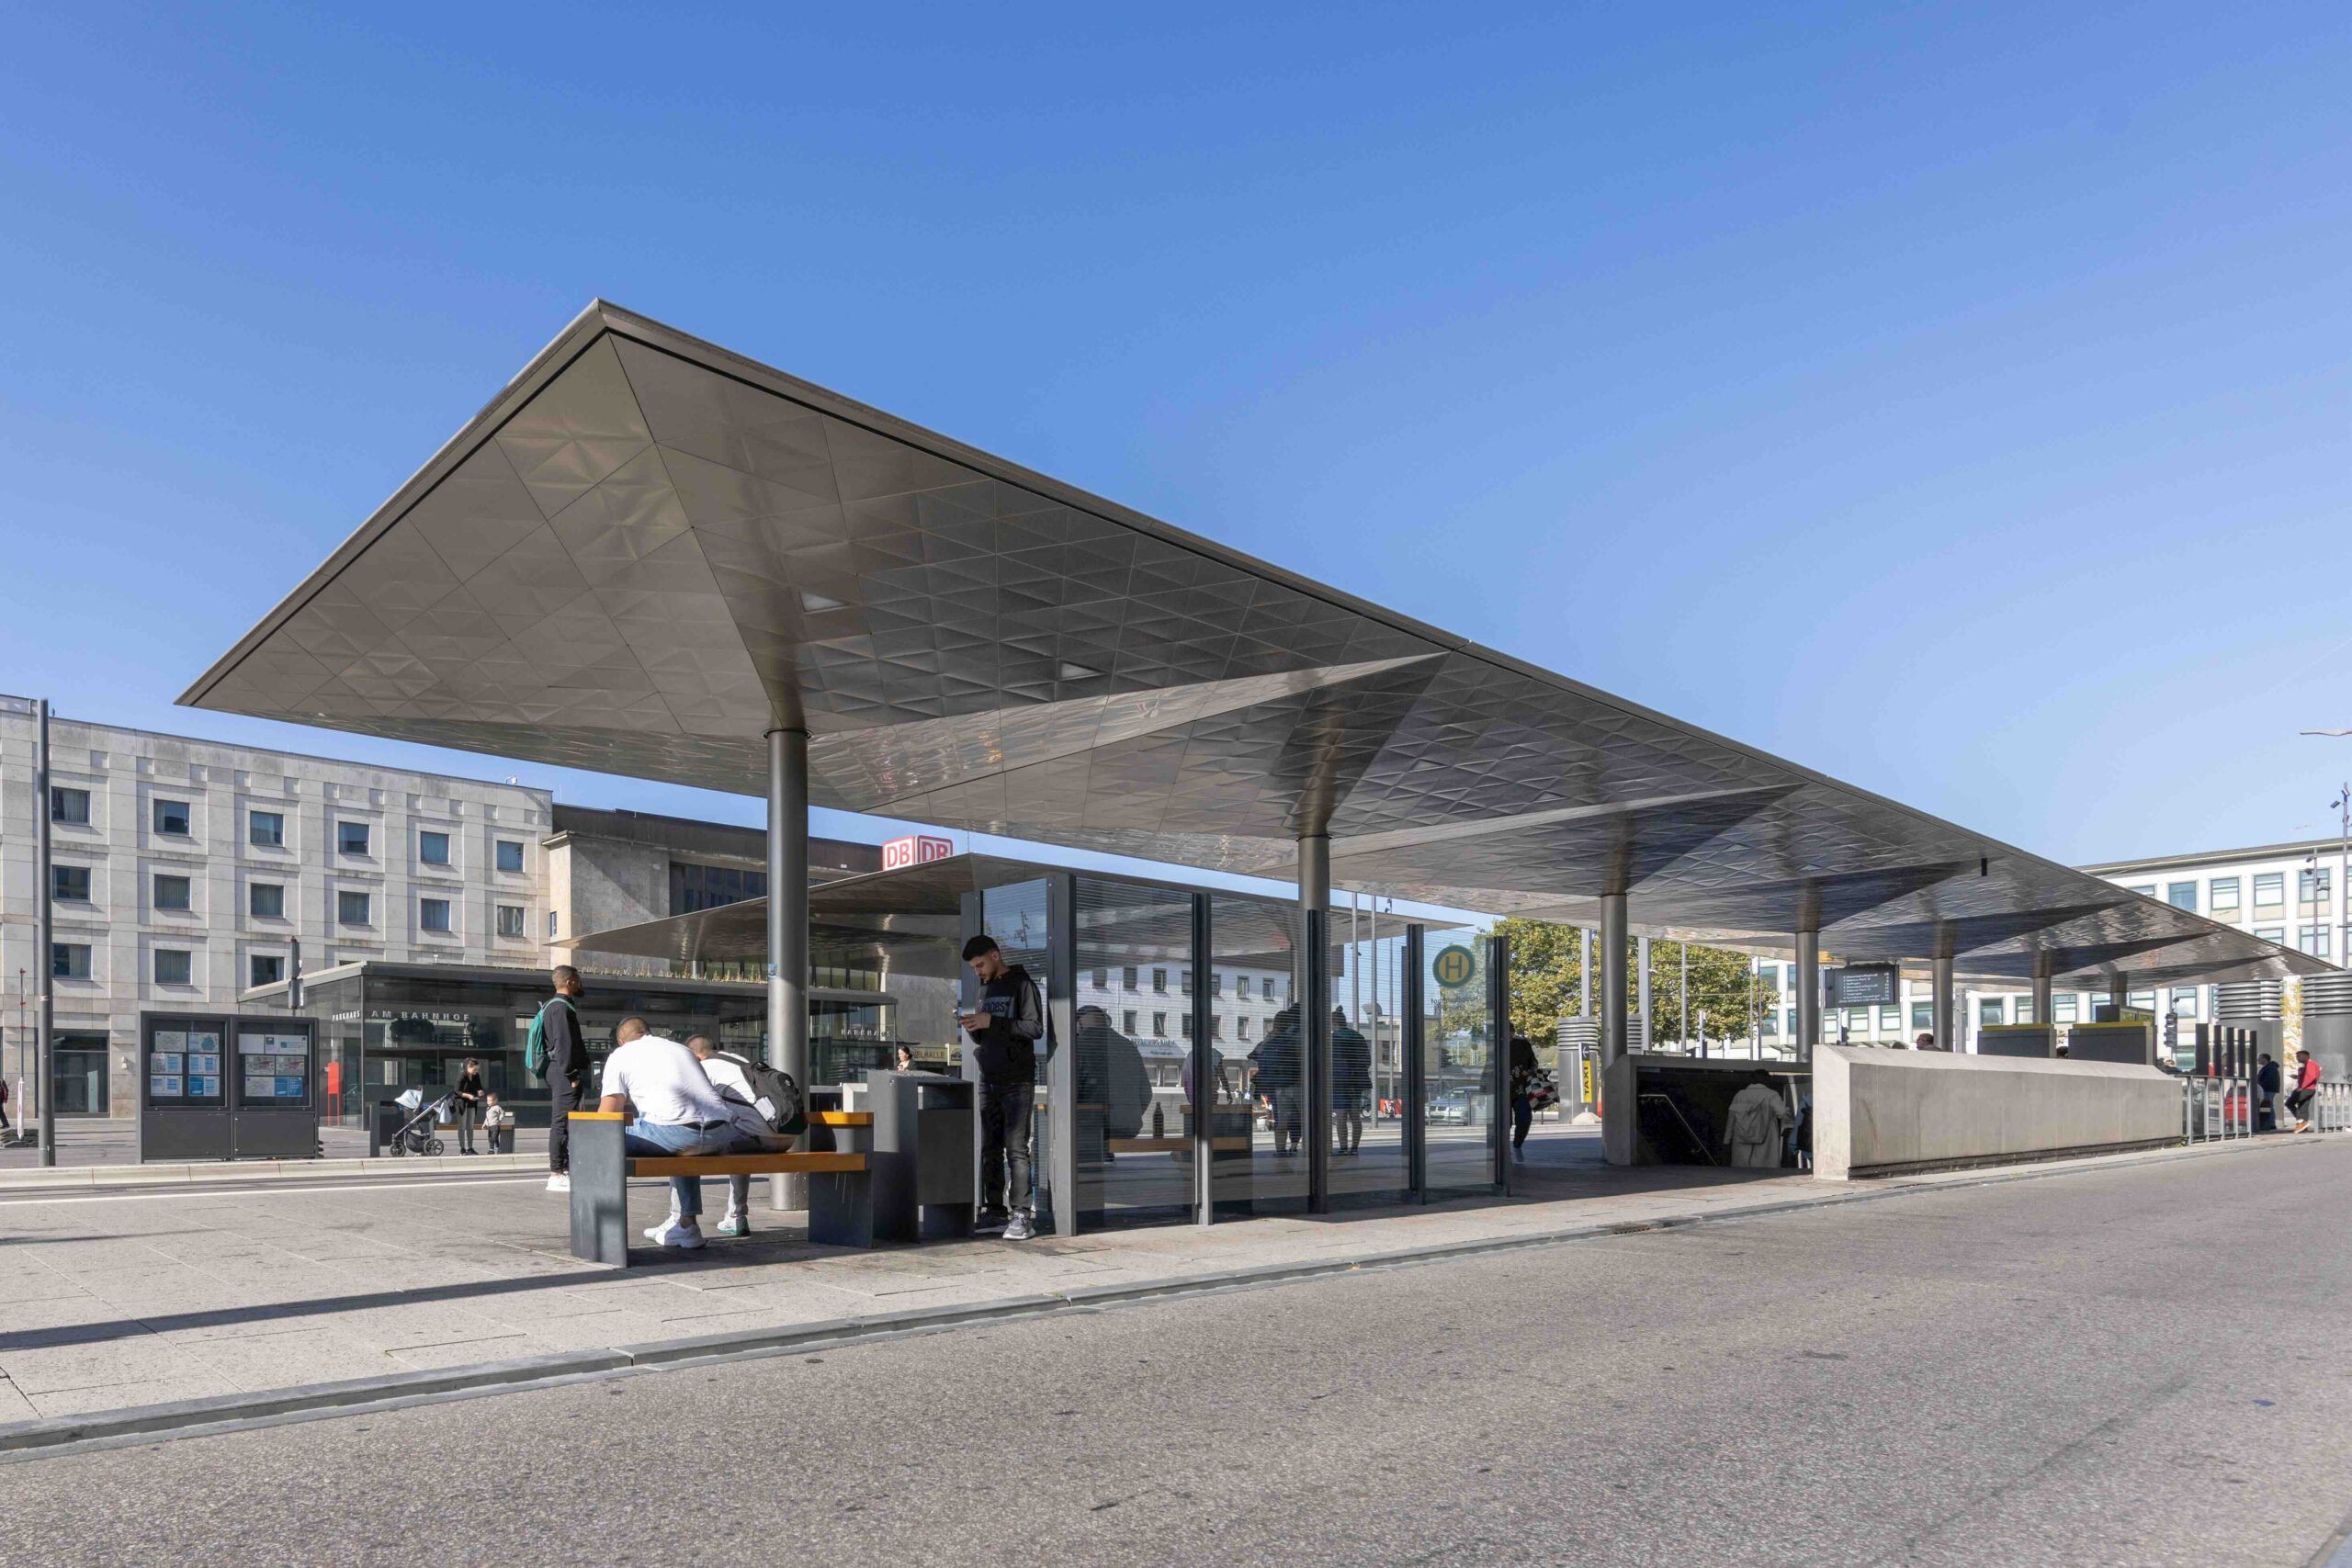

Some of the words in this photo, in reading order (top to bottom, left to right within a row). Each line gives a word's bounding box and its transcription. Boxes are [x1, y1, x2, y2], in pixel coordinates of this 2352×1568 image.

[887, 843, 910, 867] DB
[922, 841, 948, 863] DB
[1445, 954, 1463, 979] H
[332, 1010, 360, 1022] PARKHAUS
[371, 1010, 392, 1019] AM
[401, 1011, 469, 1021] BAHNHOF
